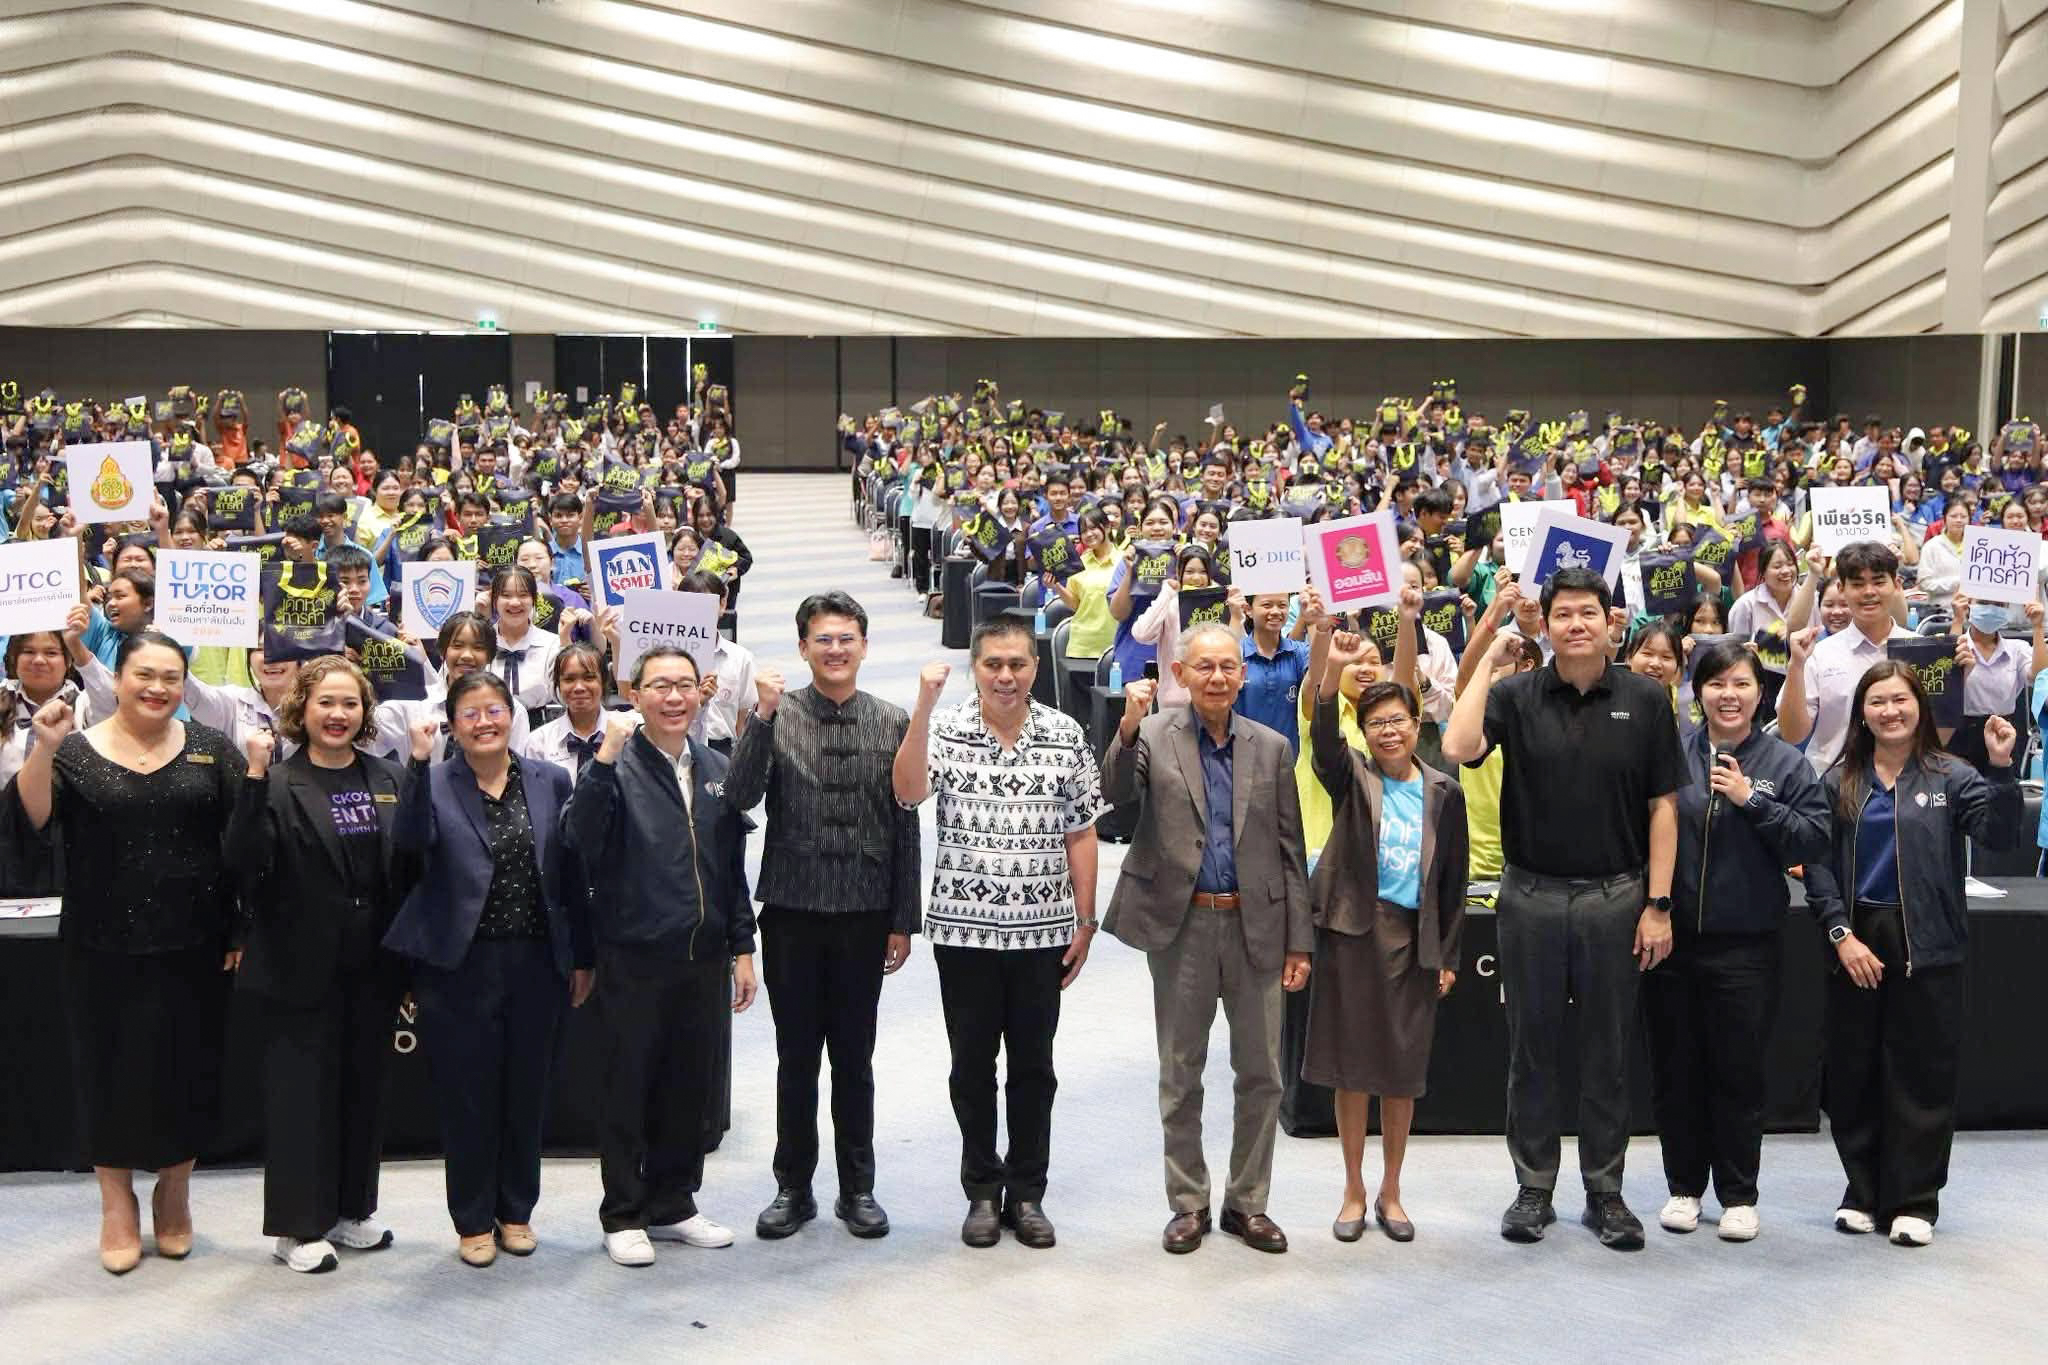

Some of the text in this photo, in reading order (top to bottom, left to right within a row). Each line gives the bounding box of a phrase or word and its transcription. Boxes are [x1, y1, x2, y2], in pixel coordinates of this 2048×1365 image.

[1508, 527, 1536, 537] CEN
[1267, 551, 1301, 563] DHC
[1970, 538, 2032, 570] เด็กหัว
[169, 560, 247, 583] UTCC
[607, 554, 652, 577] MAN
[1968, 562, 2030, 588] การค้า
[610, 573, 655, 591] SOME
[1334, 569, 1384, 590] ออมสิน
[168, 582, 247, 601] TUTOR
[629, 620, 710, 639] CENTRAL
